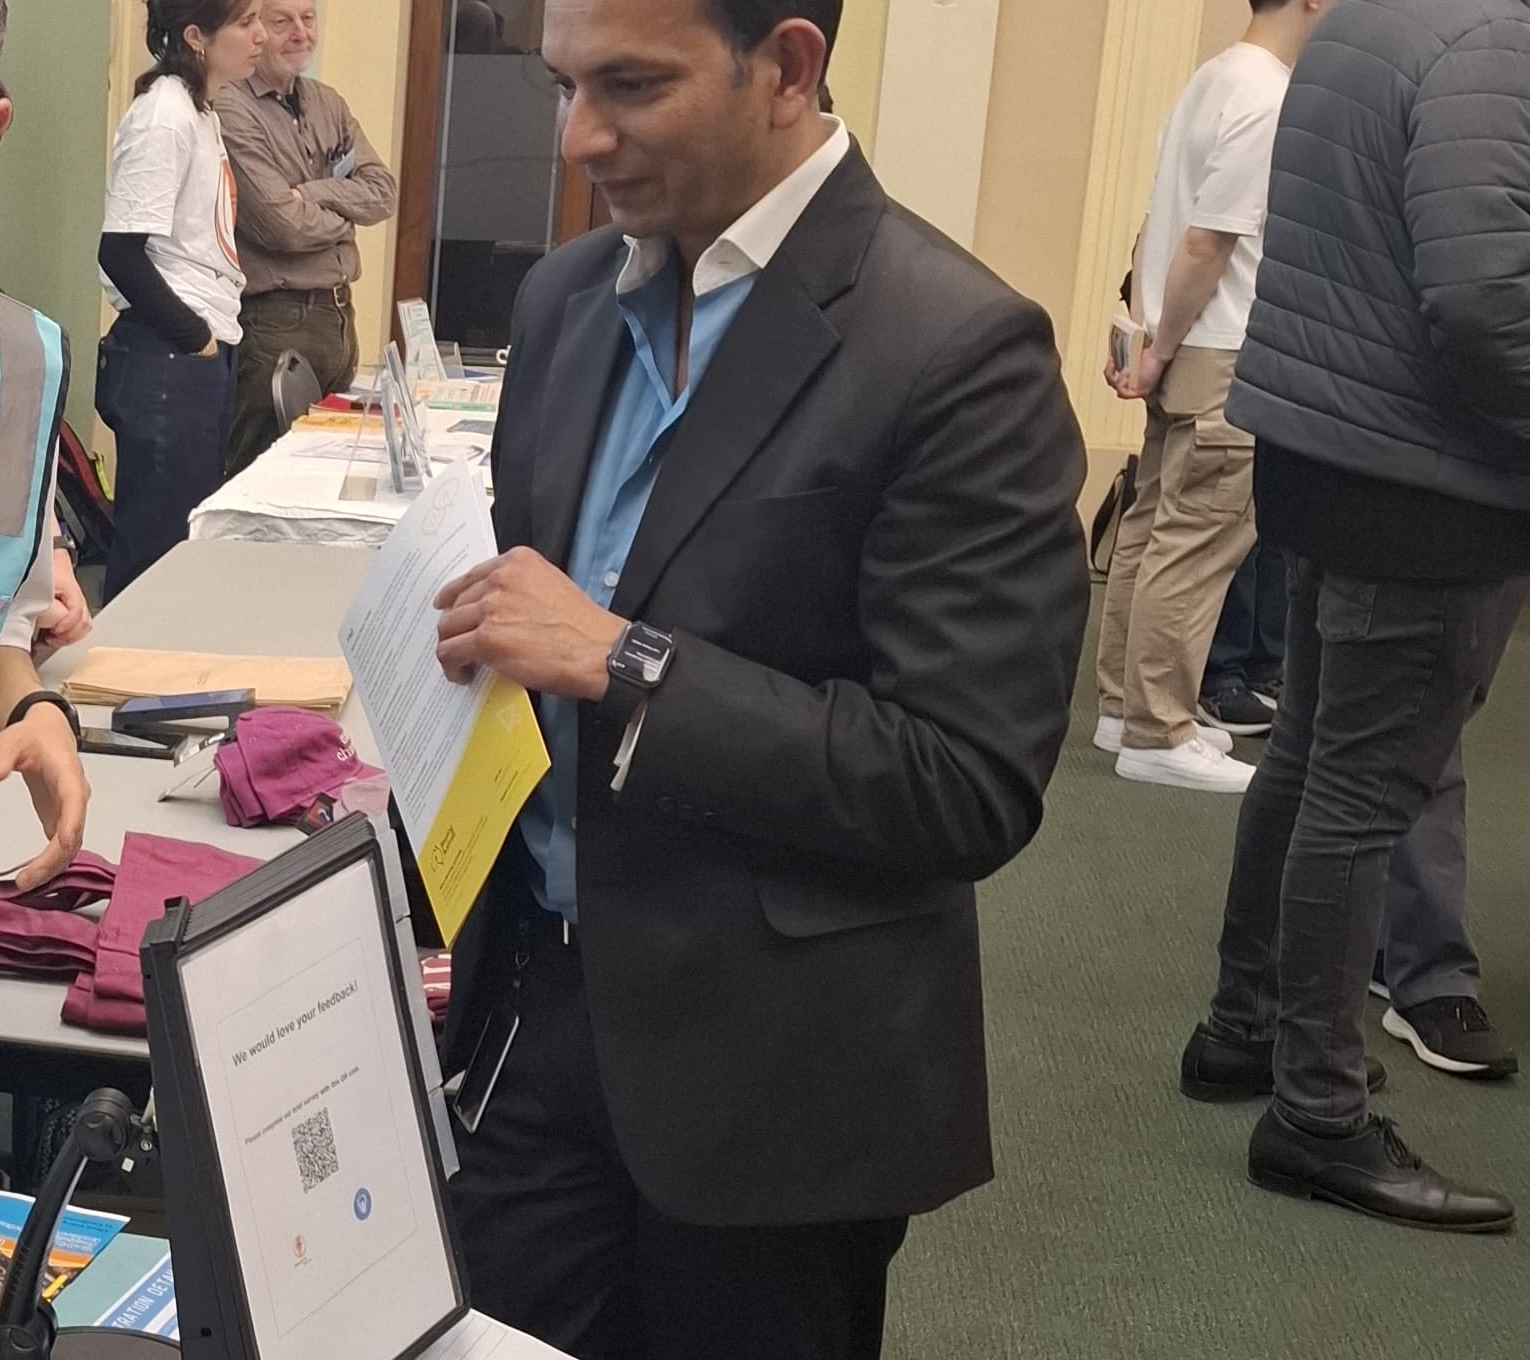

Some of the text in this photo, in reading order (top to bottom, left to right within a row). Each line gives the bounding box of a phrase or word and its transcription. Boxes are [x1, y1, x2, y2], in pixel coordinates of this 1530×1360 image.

[232, 980, 358, 1067] We would love your feedback!
